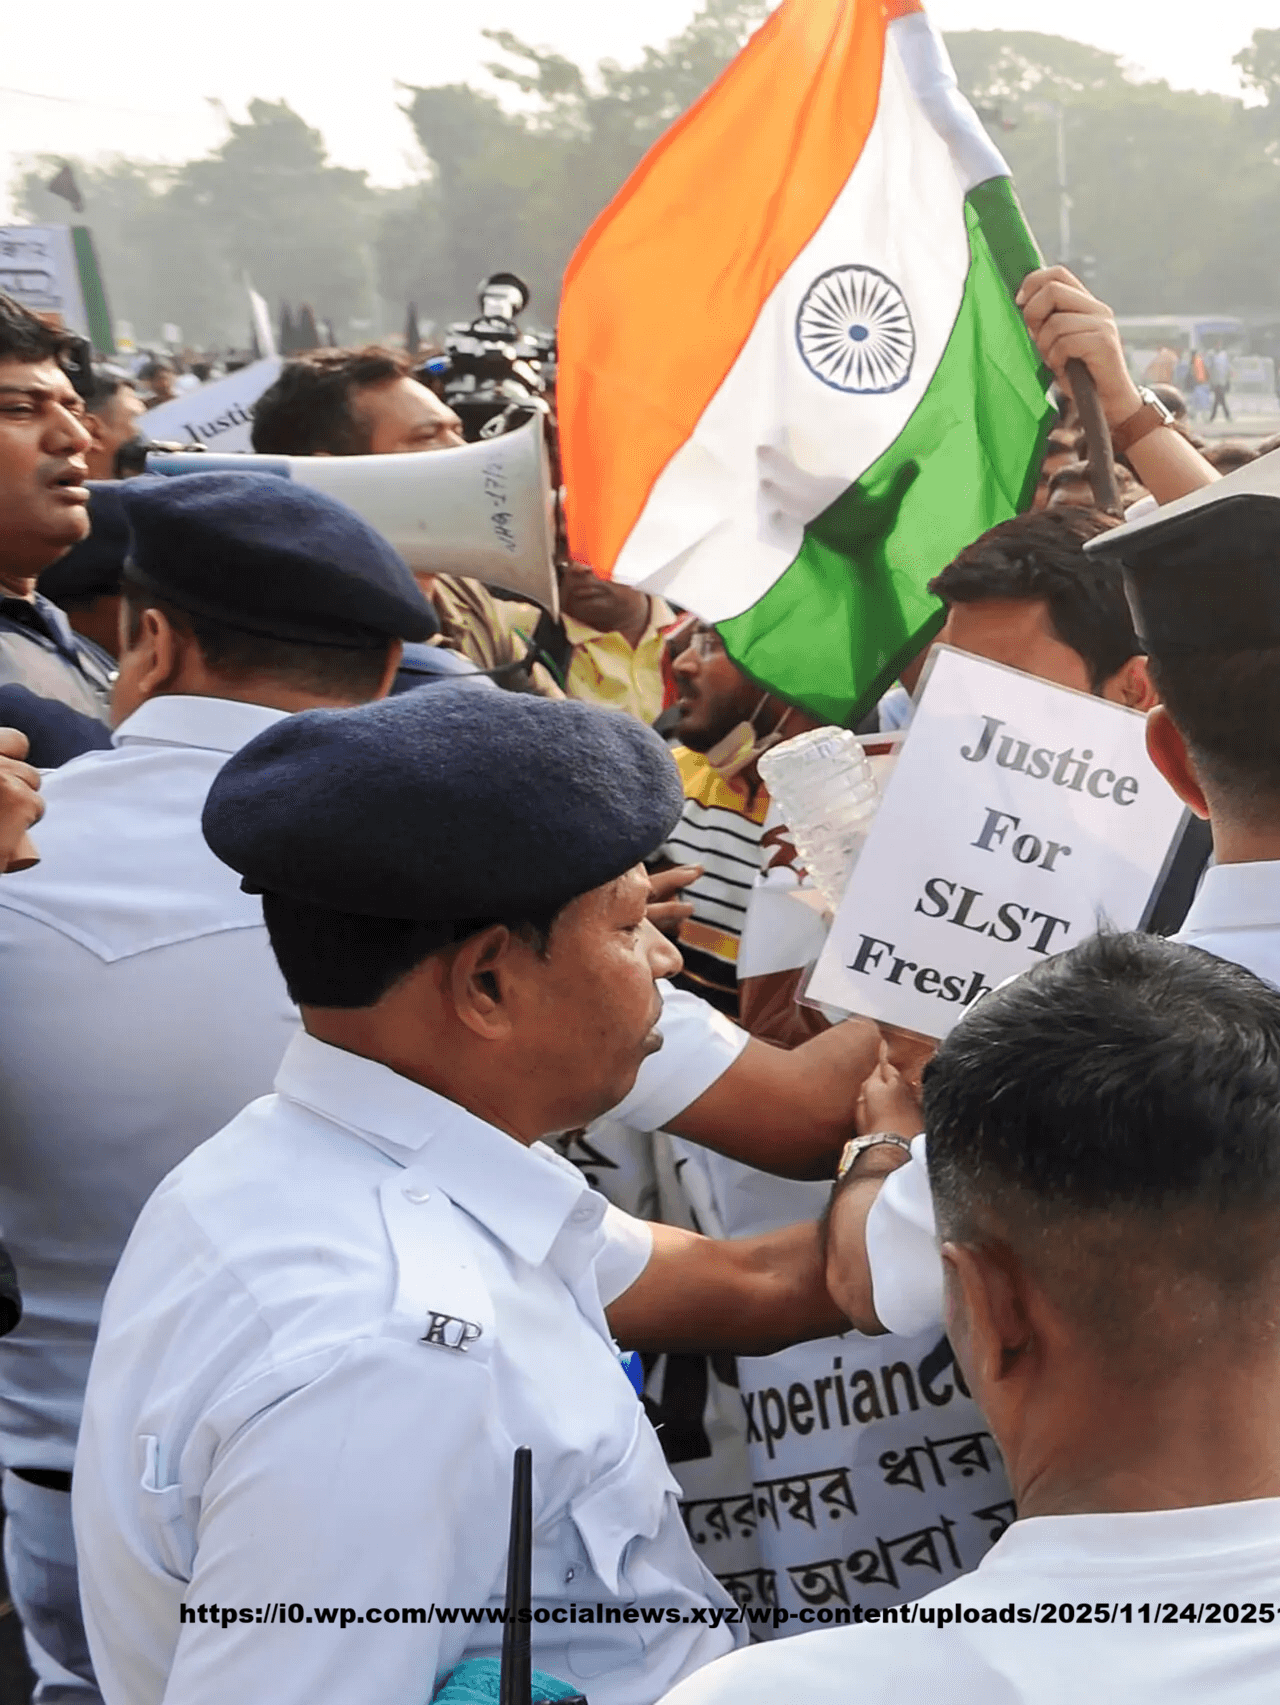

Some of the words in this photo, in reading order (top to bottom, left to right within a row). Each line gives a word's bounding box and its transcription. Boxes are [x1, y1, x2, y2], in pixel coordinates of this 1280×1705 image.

[181, 402, 254, 443] Justi
[960, 714, 1139, 806] Justice
[970, 807, 1072, 872] For
[914, 877, 1071, 956] SLST
[419, 1310, 482, 1352] KP
[741, 1350, 973, 1460] xperianc
[786, 1513, 963, 1608] অথবা
